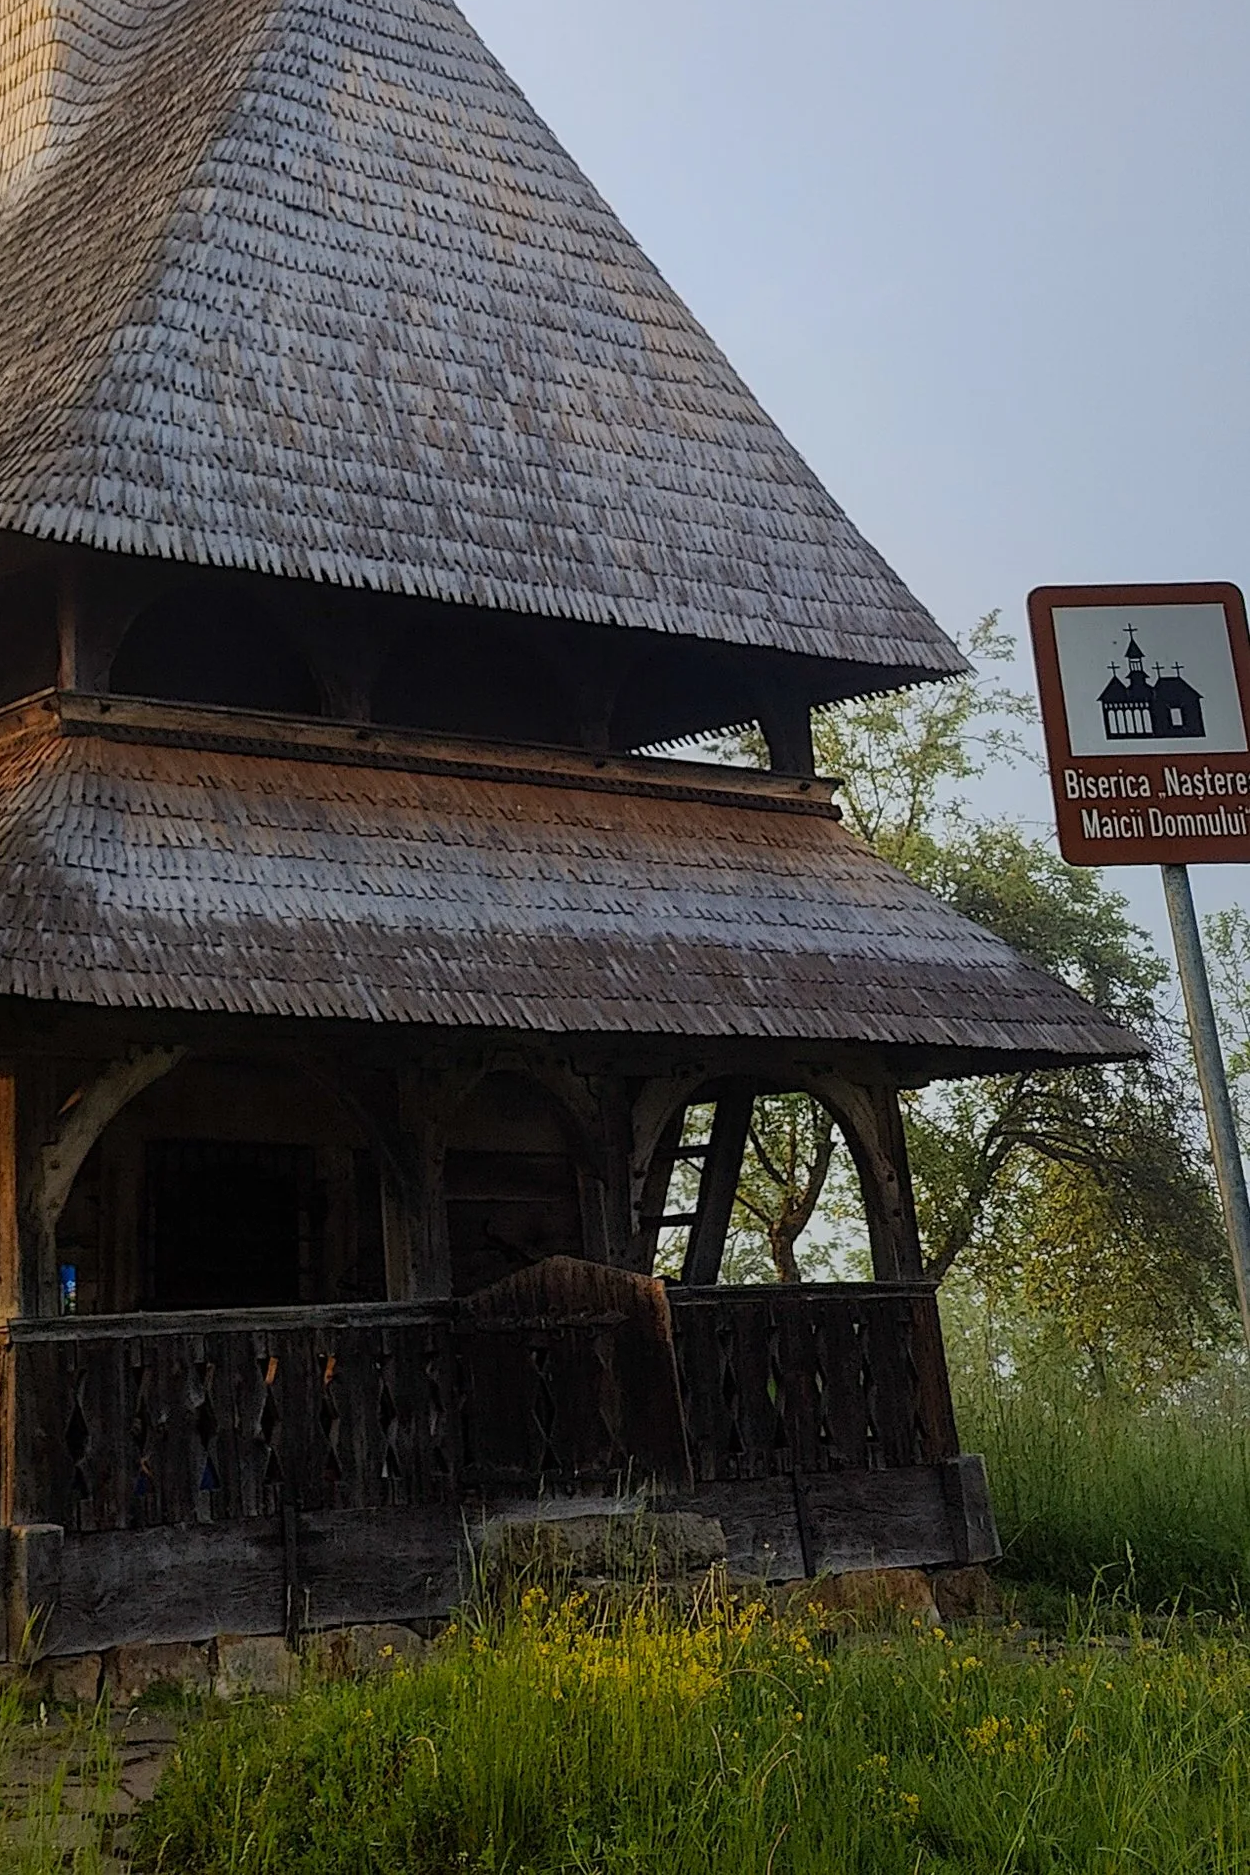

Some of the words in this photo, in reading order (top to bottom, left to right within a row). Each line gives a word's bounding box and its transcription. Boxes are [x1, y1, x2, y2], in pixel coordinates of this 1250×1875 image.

[1063, 768, 1151, 799] Biserica
[1158, 766, 1250, 800] „Naștere
[1081, 808, 1145, 839] Maicii
